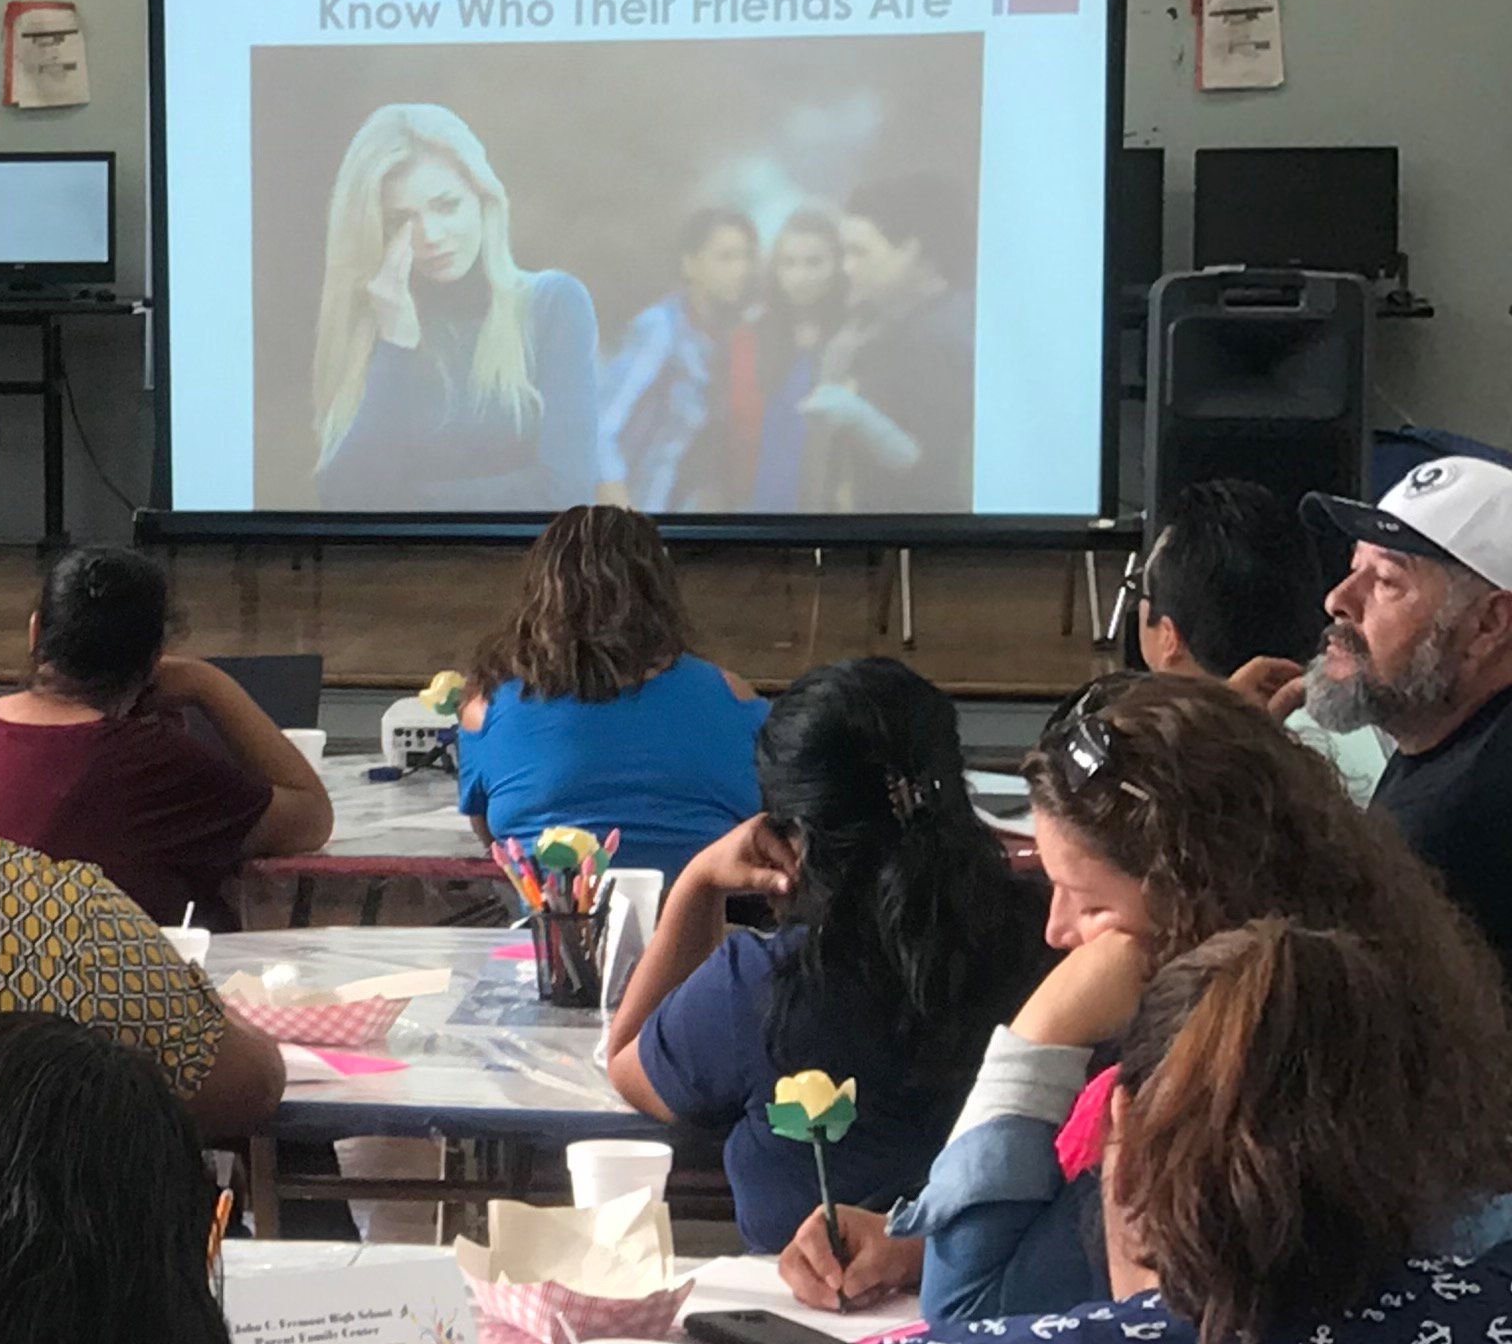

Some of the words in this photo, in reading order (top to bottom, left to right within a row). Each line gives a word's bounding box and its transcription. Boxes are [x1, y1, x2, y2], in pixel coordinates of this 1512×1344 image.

[235, 1323, 262, 1334] John
[279, 1317, 326, 1329] Fremont
[329, 1313, 355, 1325] High
[357, 1308, 393, 1320] School
[299, 1331, 338, 1344] Family
[341, 1327, 380, 1338] Center
